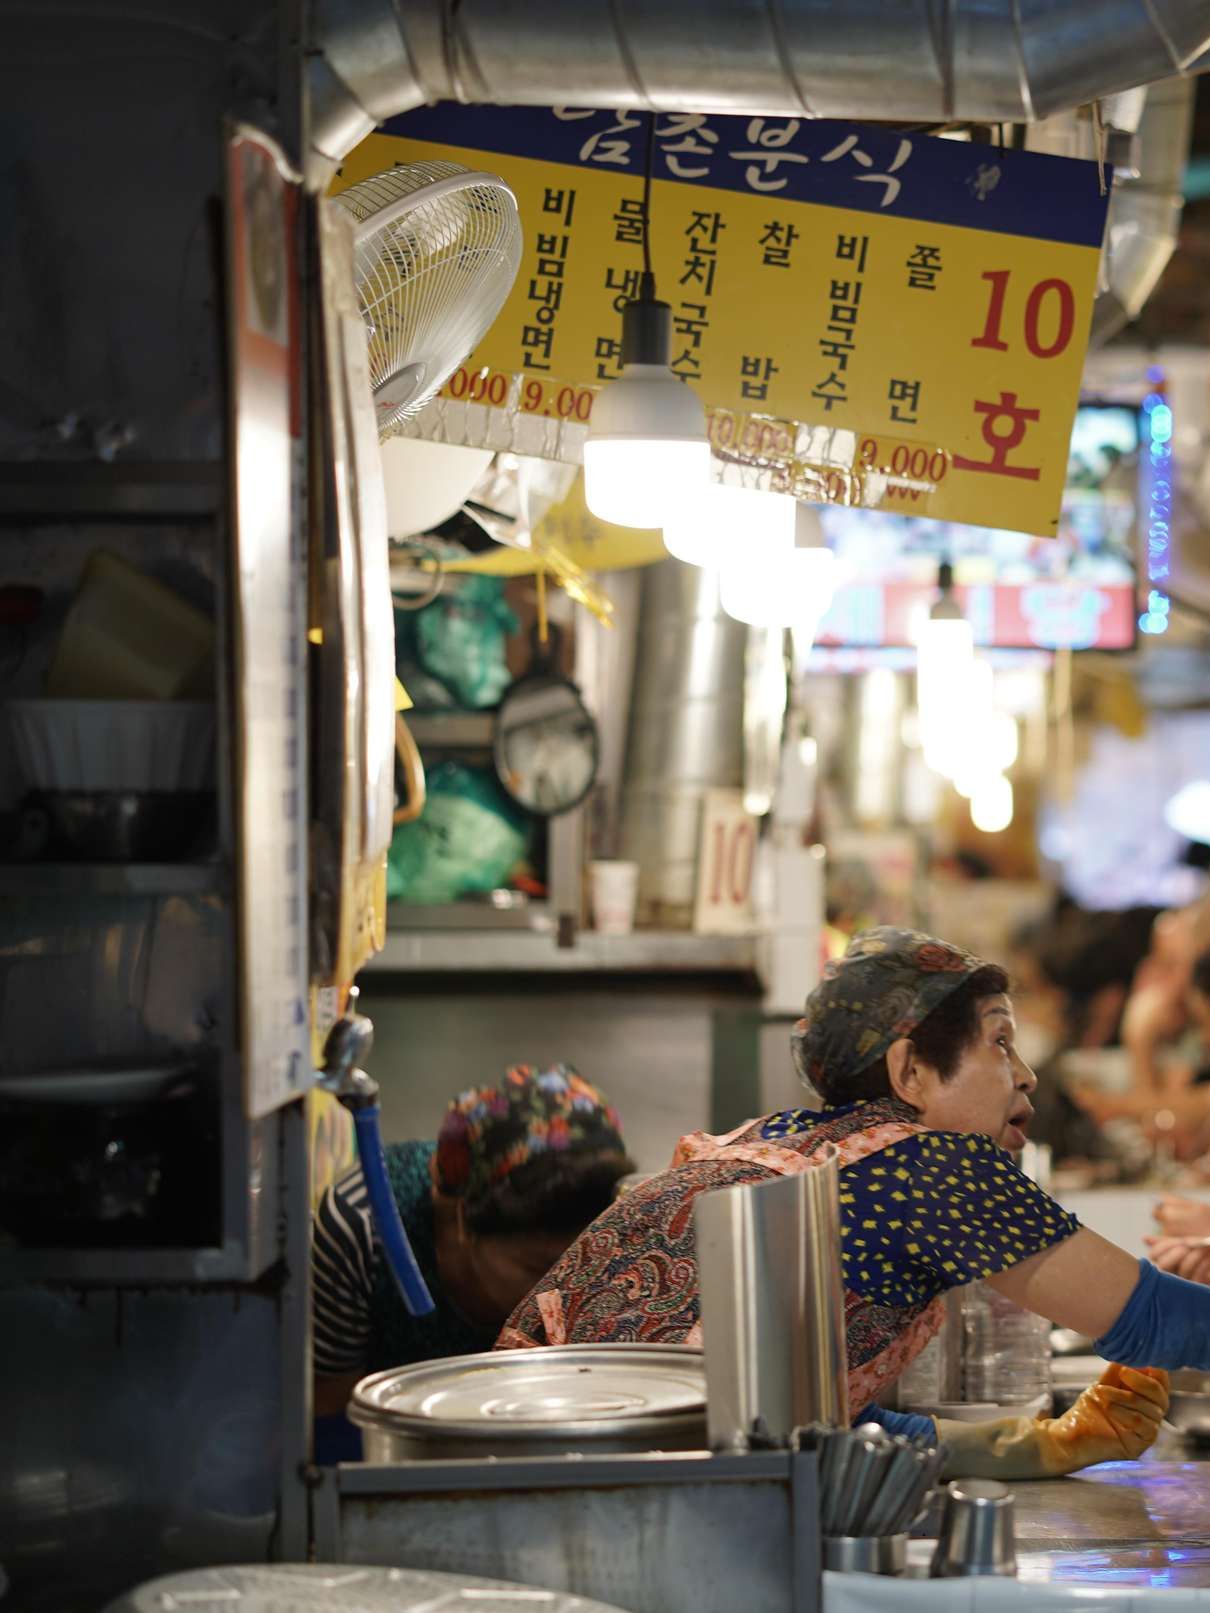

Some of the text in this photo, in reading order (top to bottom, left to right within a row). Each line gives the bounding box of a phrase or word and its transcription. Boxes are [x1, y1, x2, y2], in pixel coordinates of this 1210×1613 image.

[521, 188, 576, 370] 비빔냉면
[671, 210, 727, 383] 잔치국수
[811, 233, 870, 411] 비빔국수
[970, 269, 1076, 360] 10
[523, 380, 595, 421] 9.00
[951, 391, 1041, 482] 호
